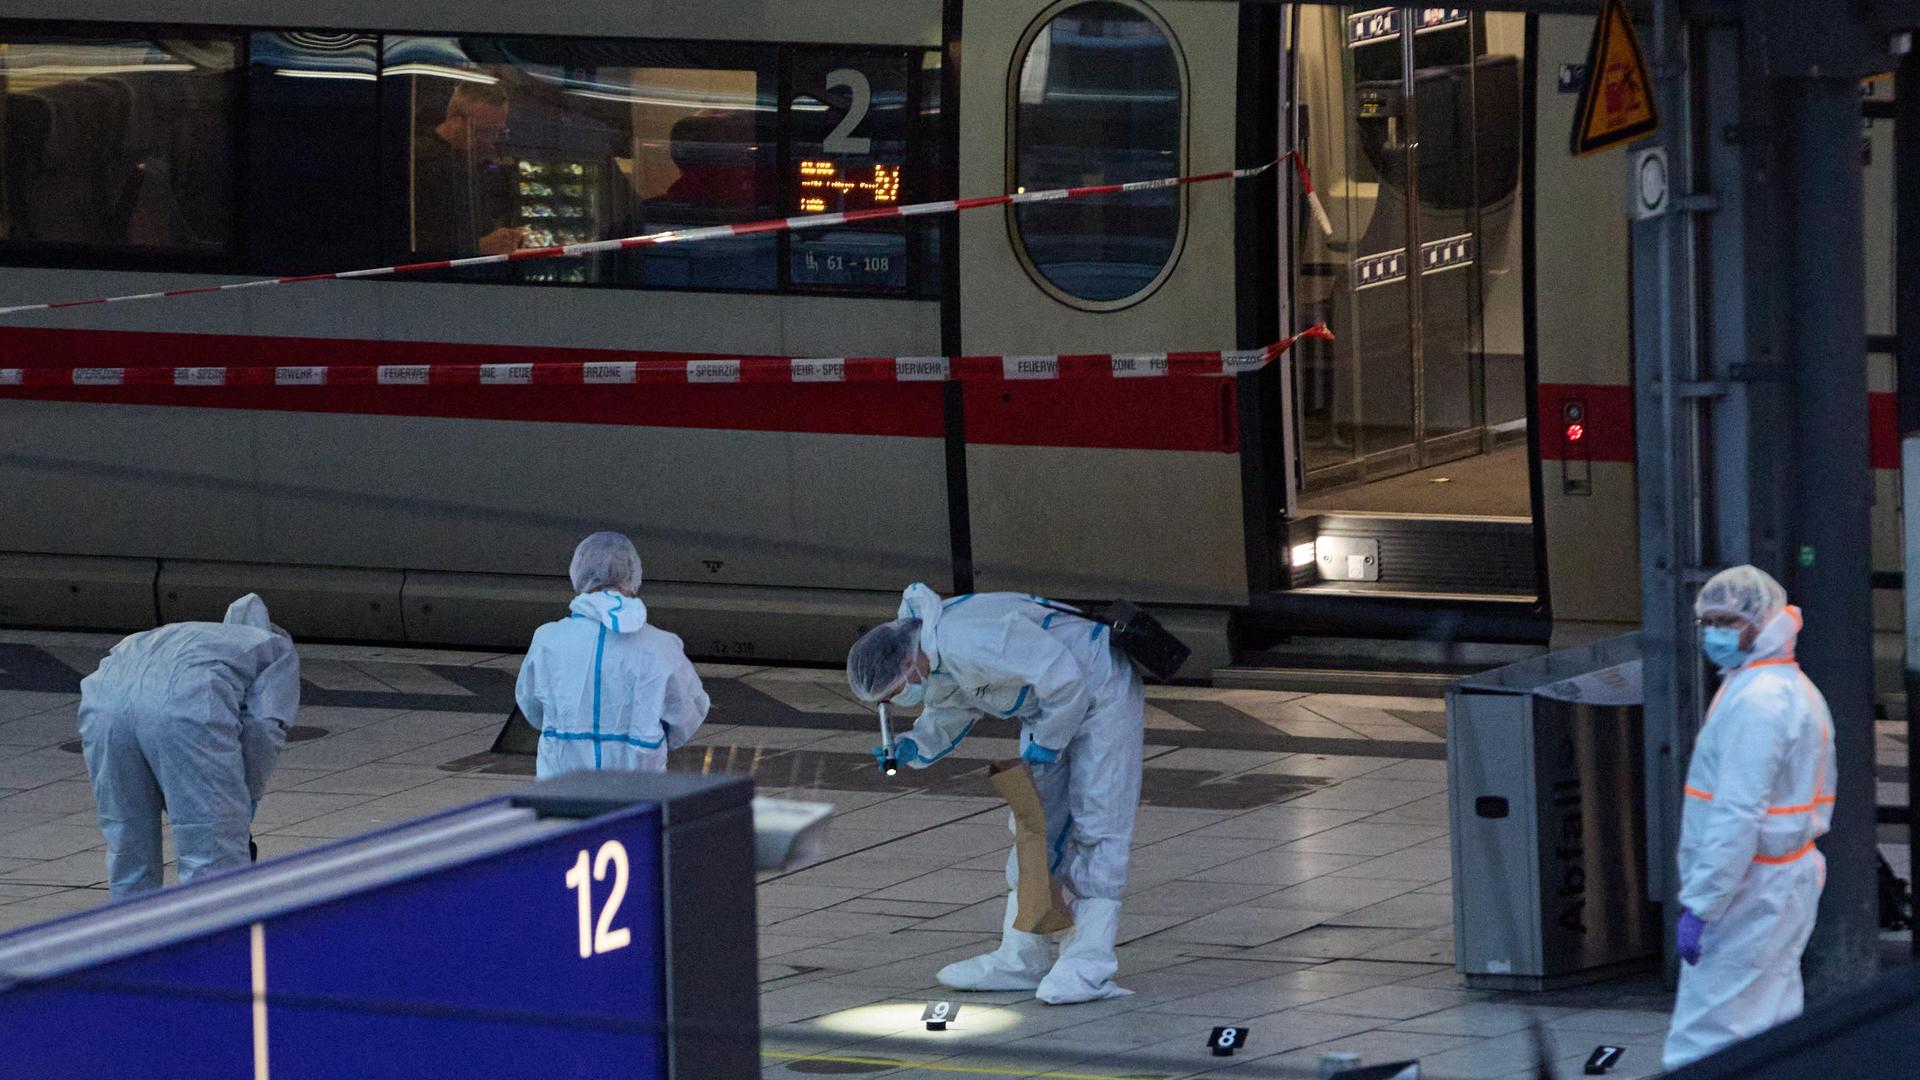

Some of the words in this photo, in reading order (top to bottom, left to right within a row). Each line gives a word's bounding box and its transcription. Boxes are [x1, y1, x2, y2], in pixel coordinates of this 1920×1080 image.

[824, 70, 871, 153] 2
[827, 255, 843, 270] 61
[864, 256, 888, 272] 108
[1554, 779, 1586, 933] Abfall
[565, 839, 631, 958] 12
[932, 1002, 950, 1019] 9
[1217, 1028, 1237, 1047] 8
[1595, 1047, 1616, 1066] 7
